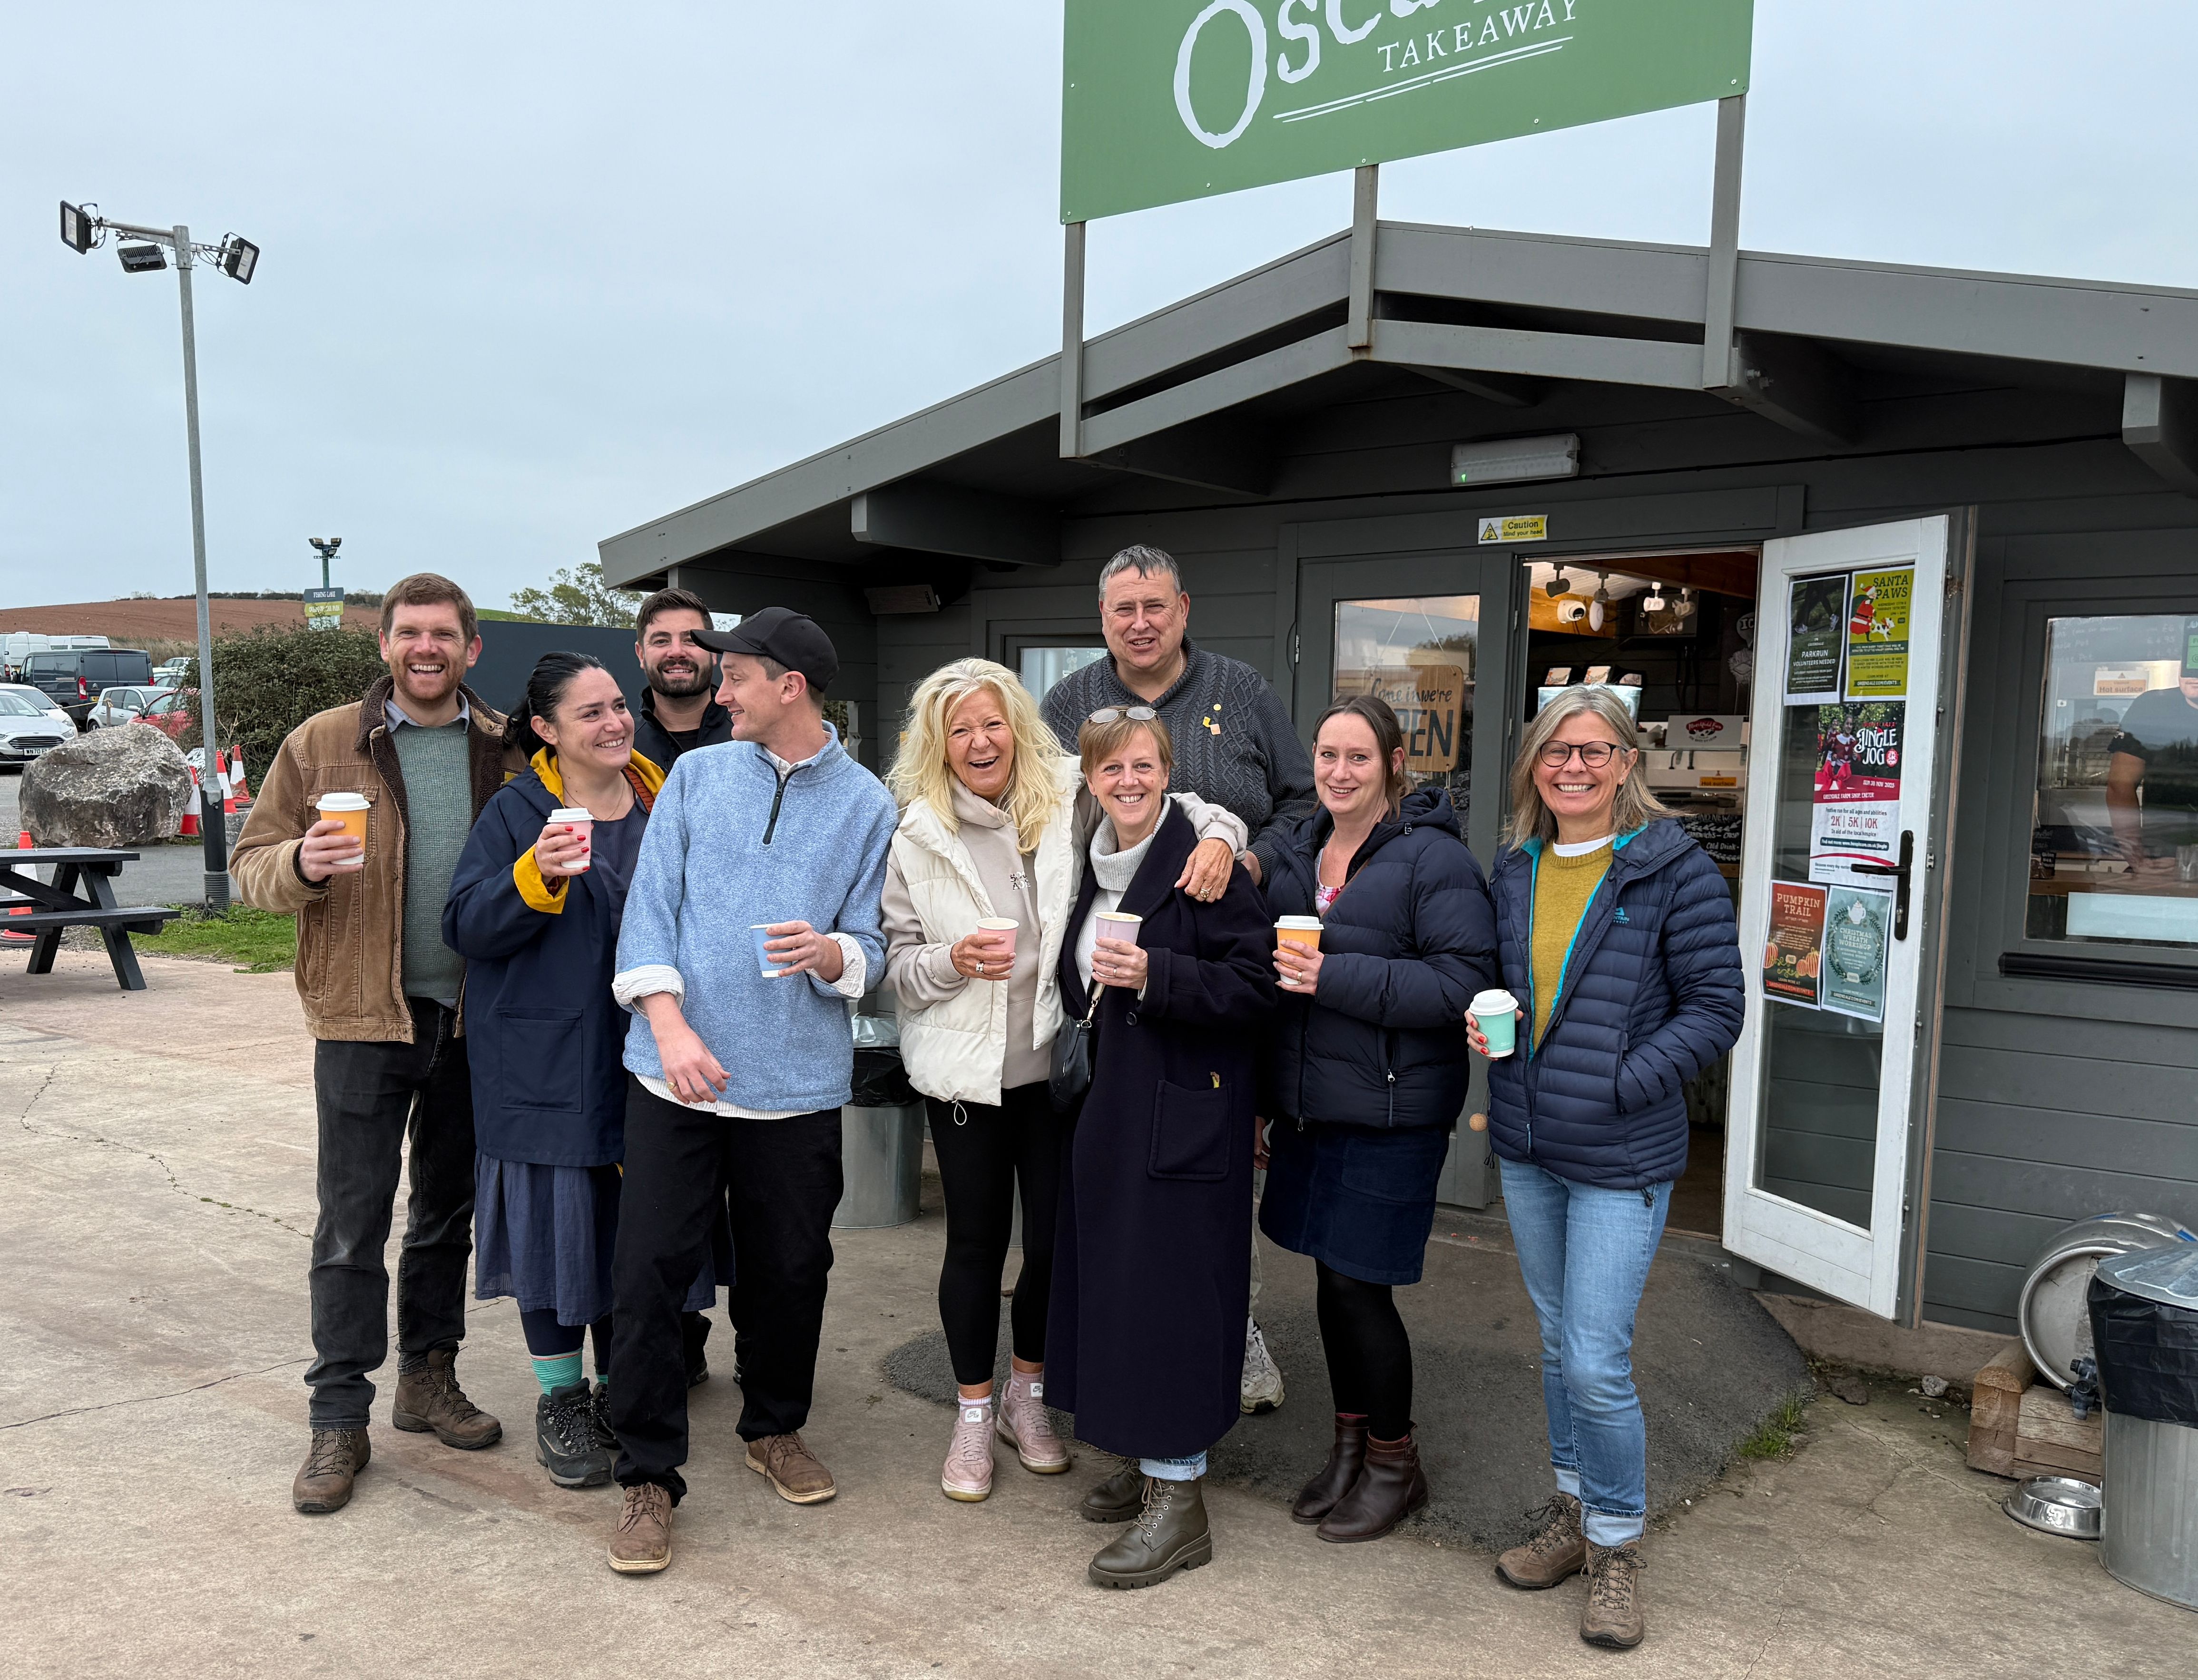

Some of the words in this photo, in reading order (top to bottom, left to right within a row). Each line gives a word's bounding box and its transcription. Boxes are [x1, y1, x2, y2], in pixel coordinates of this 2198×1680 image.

[1377, 0, 1576, 72] TAKEAWAY
[1508, 520, 1539, 529] Caution
[1873, 575, 1909, 587] SANTA
[1875, 587, 1908, 599] PAWS
[1801, 649, 1828, 658] PARKRUN
[1371, 678, 1403, 703] Come
[1405, 686, 1421, 703] in
[1421, 688, 1452, 703] we're
[1394, 708, 1454, 757] PEN
[1854, 728, 1897, 753] JINGLE
[1862, 747, 1885, 765] JOG
[1831, 815, 1841, 827] 2K
[1848, 817, 1859, 828] 5K
[1865, 818, 1878, 829] 10K
[1776, 893, 1821, 908] PUMPKIN
[1784, 904, 1811, 917] TRAIL
[1840, 928, 1872, 938] CHRISTMAS
[1843, 934, 1868, 944] WREATH
[1839, 939, 1872, 950] WORKSHOP
